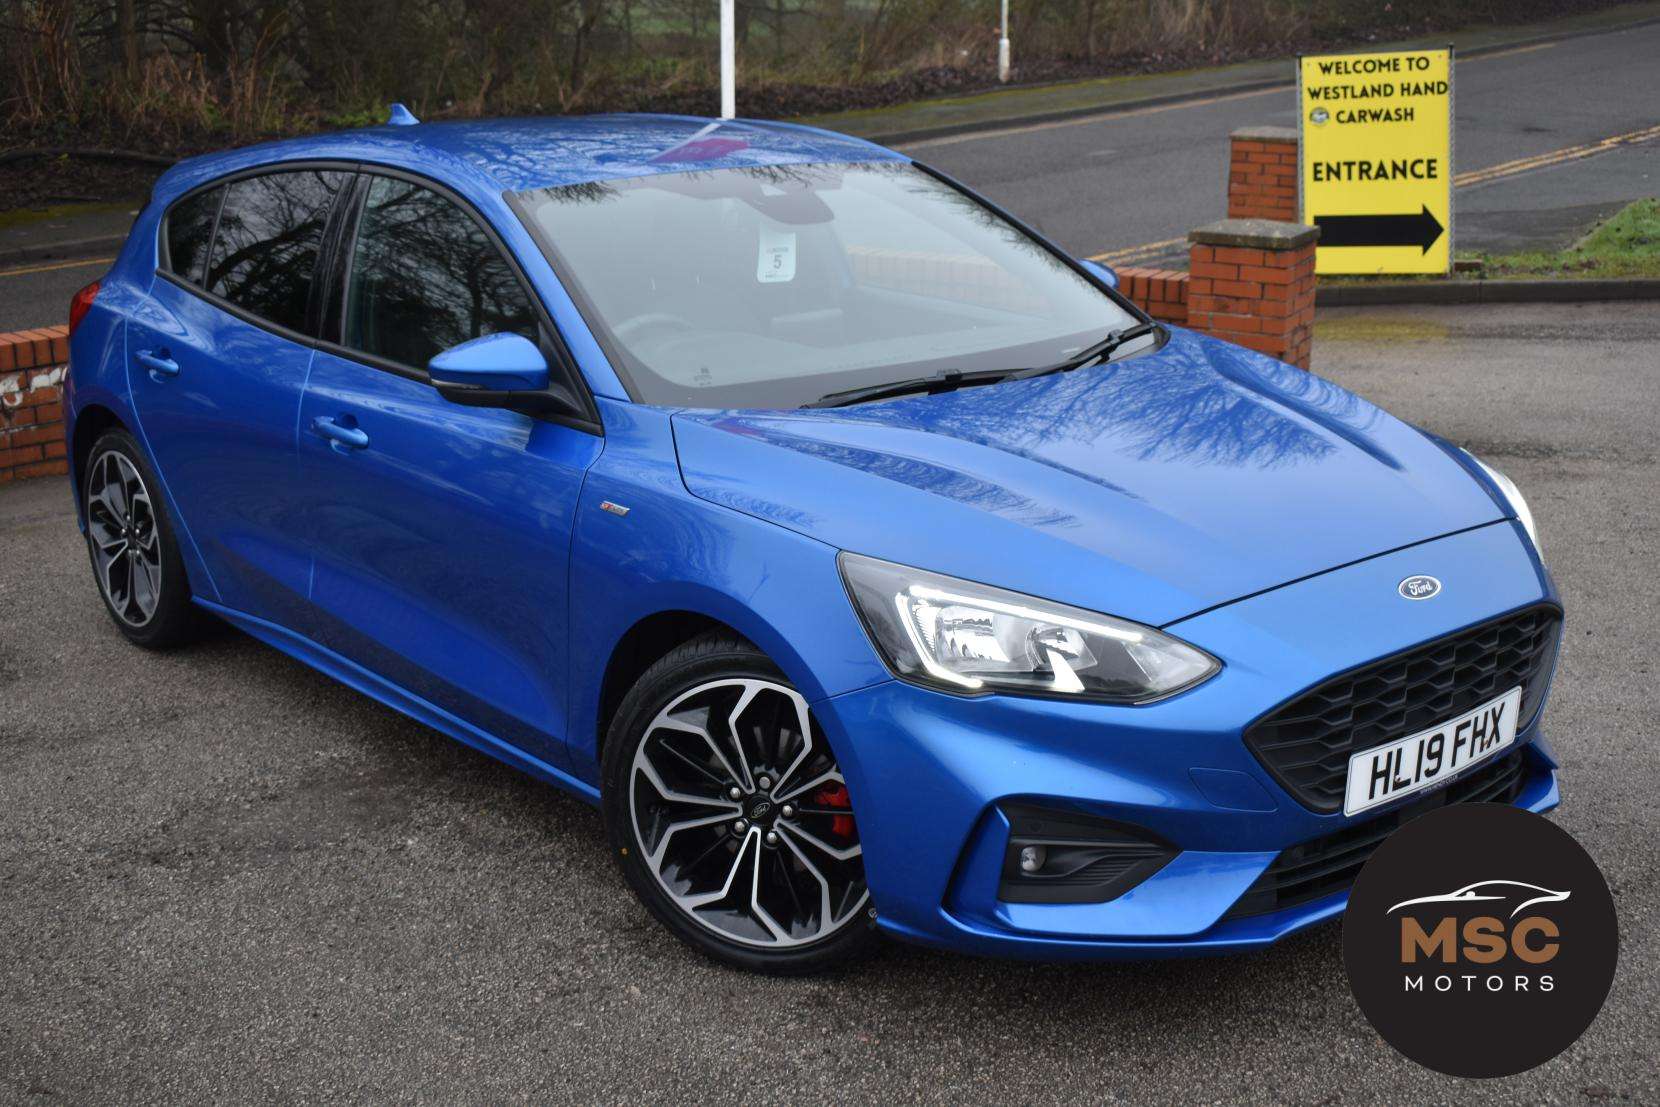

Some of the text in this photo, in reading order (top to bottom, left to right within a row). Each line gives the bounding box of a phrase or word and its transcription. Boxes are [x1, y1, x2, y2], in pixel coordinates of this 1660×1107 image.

[1319, 56, 1430, 75] WELCOME TO
[1308, 81, 1448, 100] WESTLAND HAND
[1336, 107, 1414, 124] CARWASH
[1313, 159, 1438, 182] ENTRANCE
[773, 254, 782, 269] 5
[1368, 701, 1505, 800] HL19 FHX
